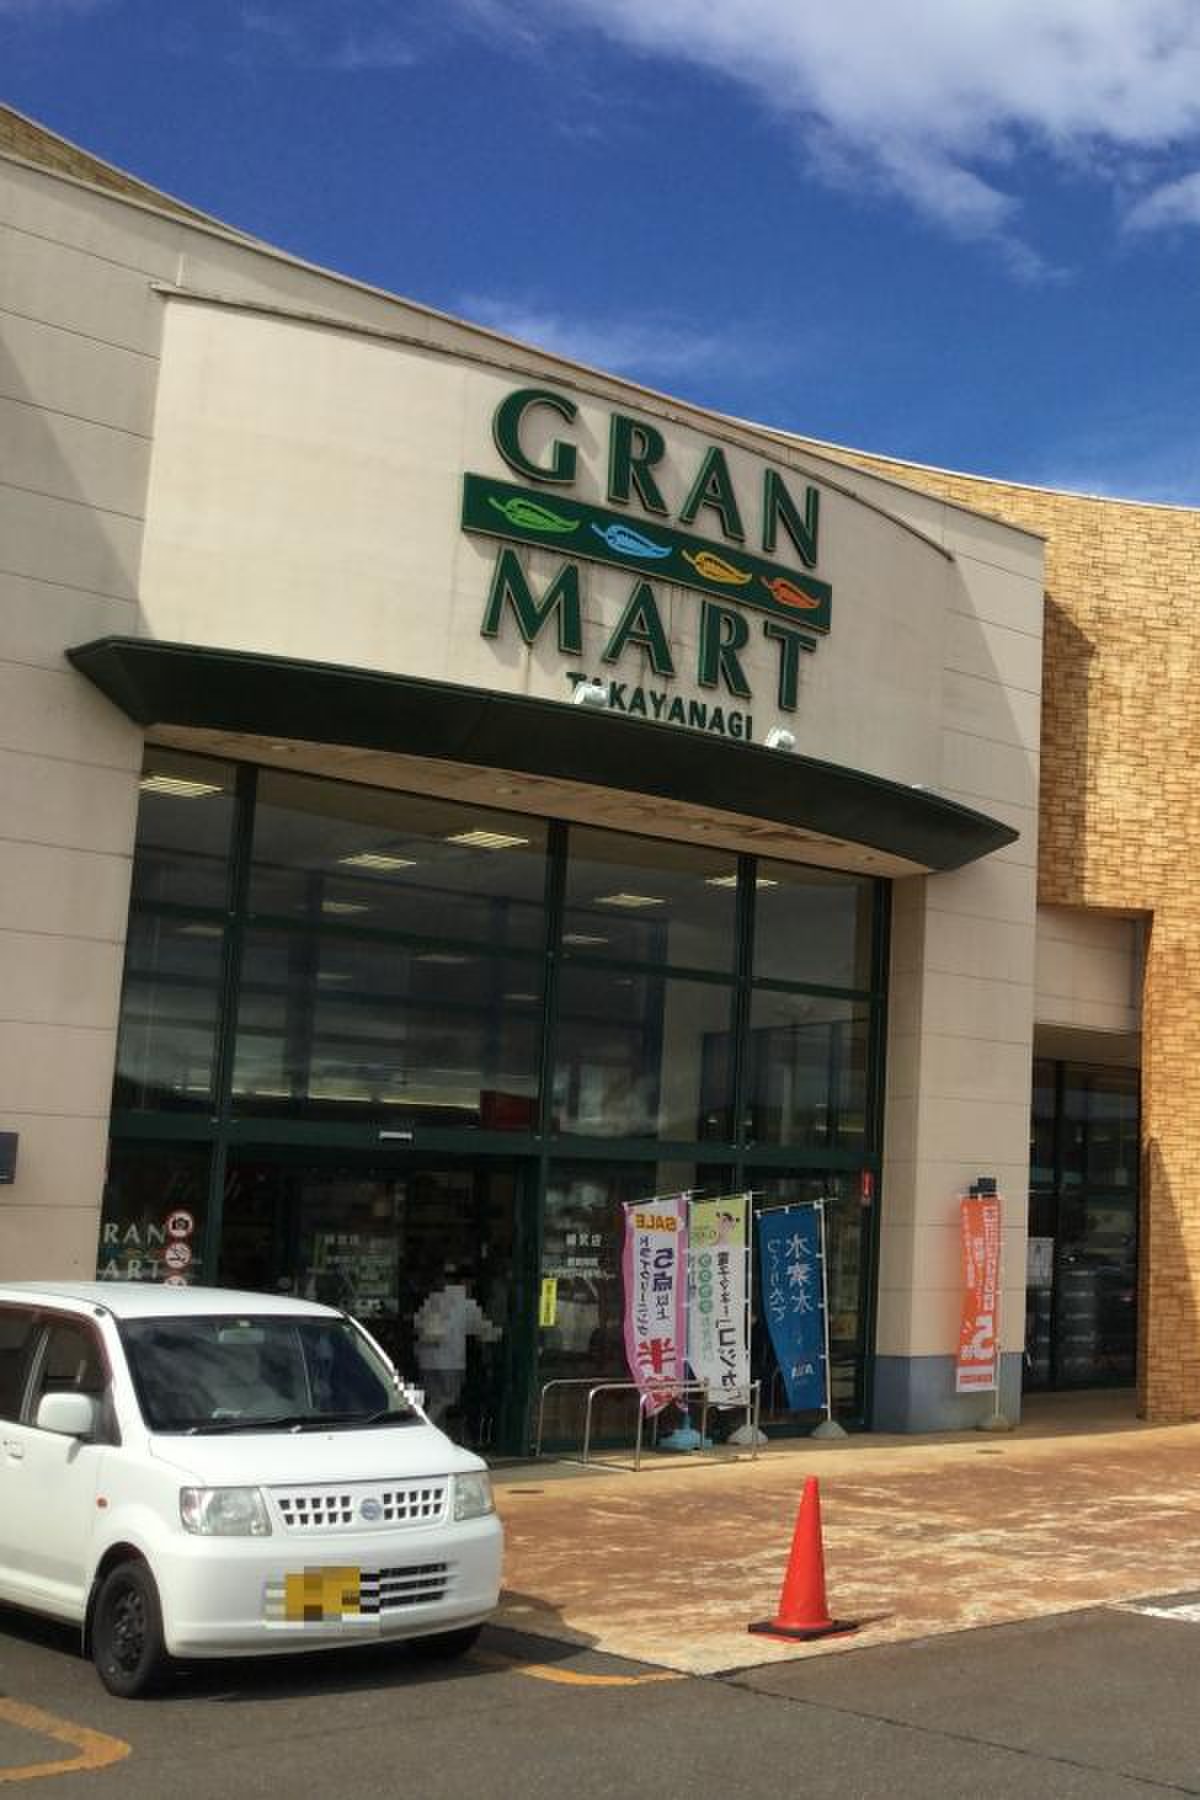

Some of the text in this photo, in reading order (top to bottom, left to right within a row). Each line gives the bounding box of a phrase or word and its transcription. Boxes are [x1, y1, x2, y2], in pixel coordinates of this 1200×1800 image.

[492, 388, 820, 569] GRAN
[479, 548, 817, 713] MART
[566, 671, 752, 740] TKAYANAGI
[103, 1222, 165, 1244] RAN
[102, 1259, 160, 1280] ART
